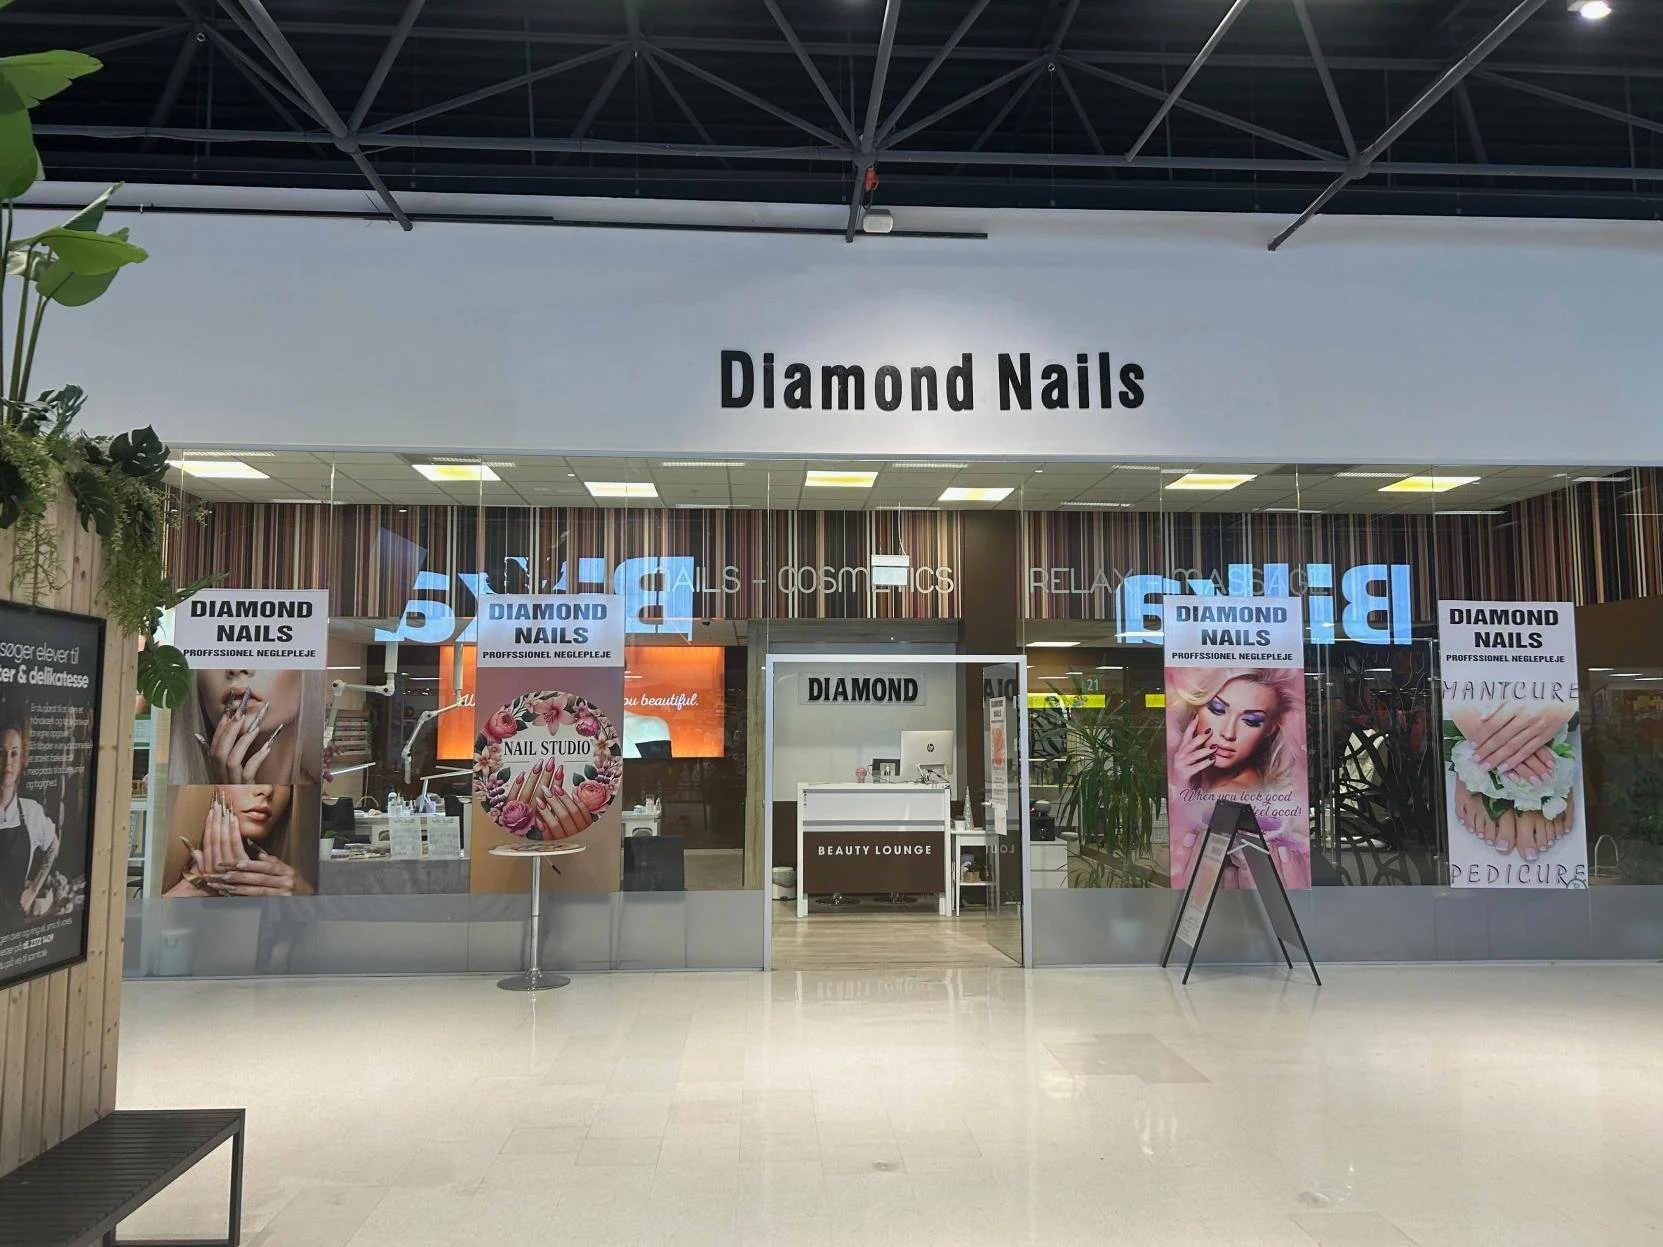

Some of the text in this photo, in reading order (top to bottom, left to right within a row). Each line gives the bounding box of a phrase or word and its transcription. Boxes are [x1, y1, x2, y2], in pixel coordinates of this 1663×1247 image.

[721, 350, 1145, 411] Diamond Nails
[1029, 567, 1133, 595] RELAX
[190, 600, 313, 618] DIAMOND
[489, 603, 608, 620] DIAMOND
[1176, 605, 1288, 623] DIAMOND
[1449, 608, 1559, 625] DIAMOND
[216, 625, 293, 643] NAILS
[515, 627, 589, 644] NAILS
[1201, 629, 1271, 646] NAILS
[1474, 631, 1543, 648] NAILS
[36, 642, 69, 664] elever
[70, 646, 80, 665] til
[256, 649, 316, 657] NEGLEPLEJE
[482, 651, 612, 659] PROFFSSIONEL NEGLEPLEJE
[1172, 652, 1237, 660] PROFFSSIONEL
[1446, 654, 1565, 663] PROFFSSIONEL NEGLEPLEJE
[17, 664, 27, 684] &
[29, 666, 89, 689] delikatesse
[808, 677, 918, 701] DIAMOND
[624, 693, 699, 711] ou beautiful.
[504, 740, 591, 756] NAIL STUDIO
[1180, 788, 1293, 805] When you look good
[818, 845, 931, 855] BEAUTY LOUNGE
[1451, 864, 1586, 886] PEDICURE
